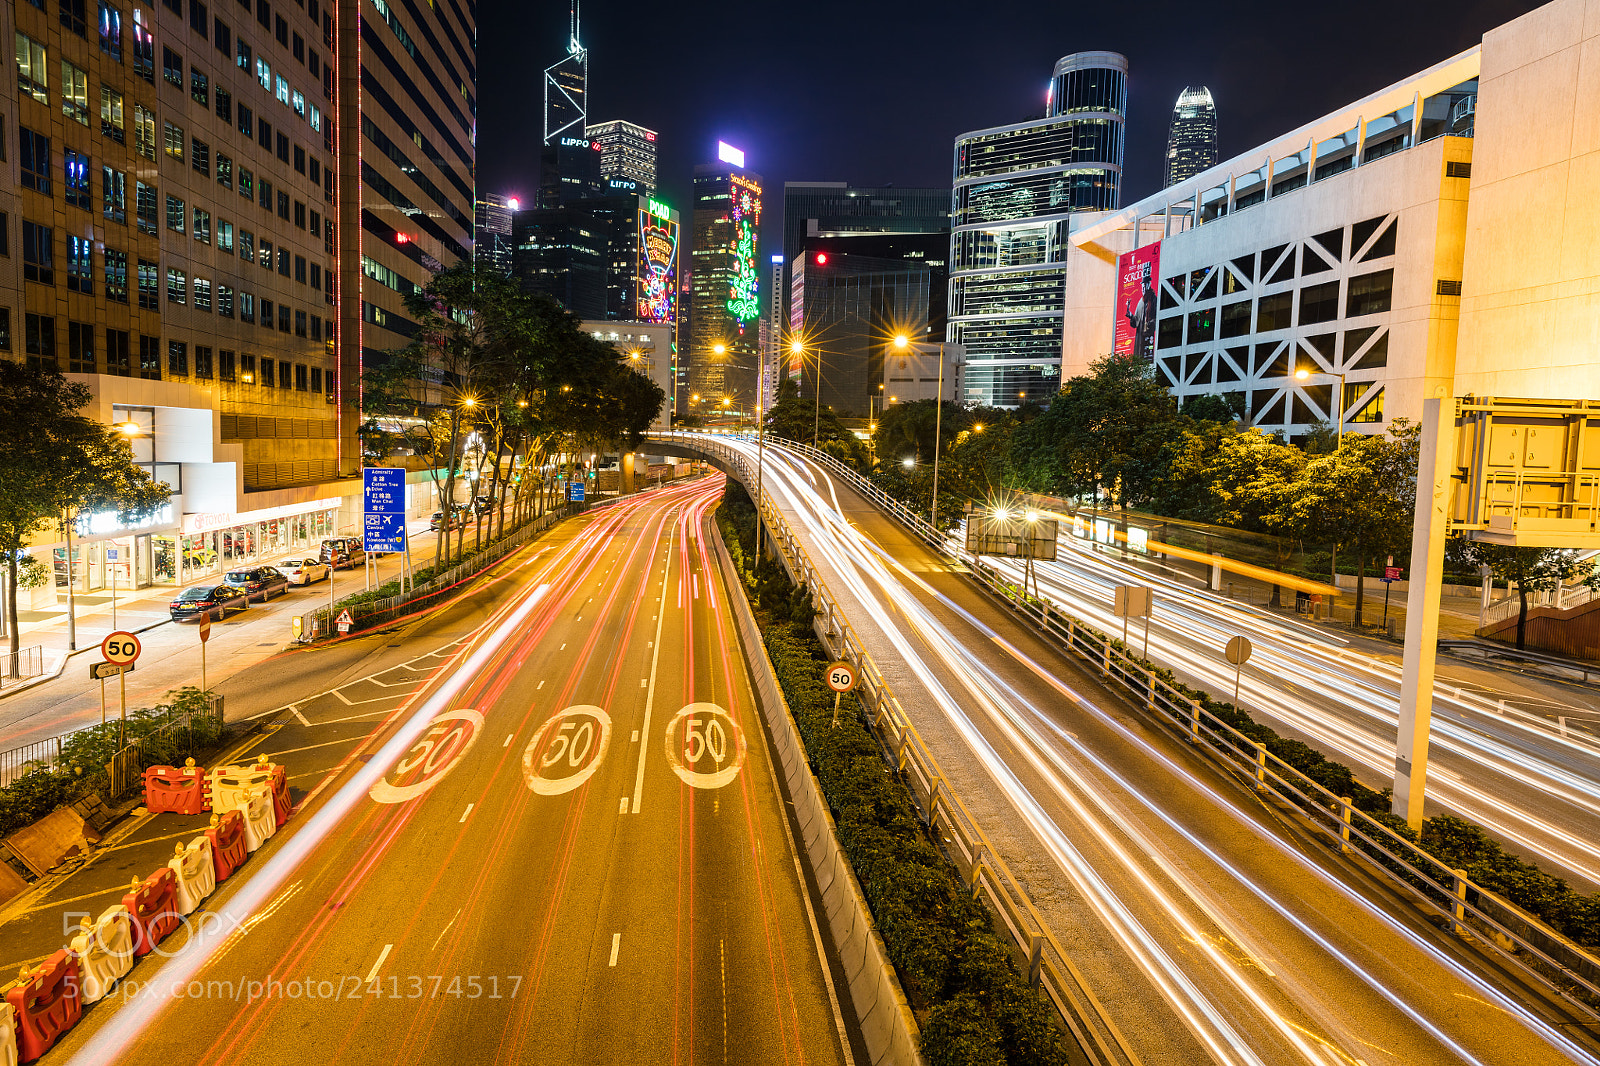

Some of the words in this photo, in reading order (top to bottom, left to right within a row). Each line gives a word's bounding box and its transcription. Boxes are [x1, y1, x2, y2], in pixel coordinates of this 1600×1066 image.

[561, 137, 589, 148] LIPPO
[649, 199, 670, 220] POAD
[204, 512, 231, 526] TOYOTA
[108, 641, 136, 657] 50
[832, 672, 850, 685] 50
[541, 719, 594, 768] 50
[684, 719, 727, 763] 50
[396, 727, 464, 774] 50
